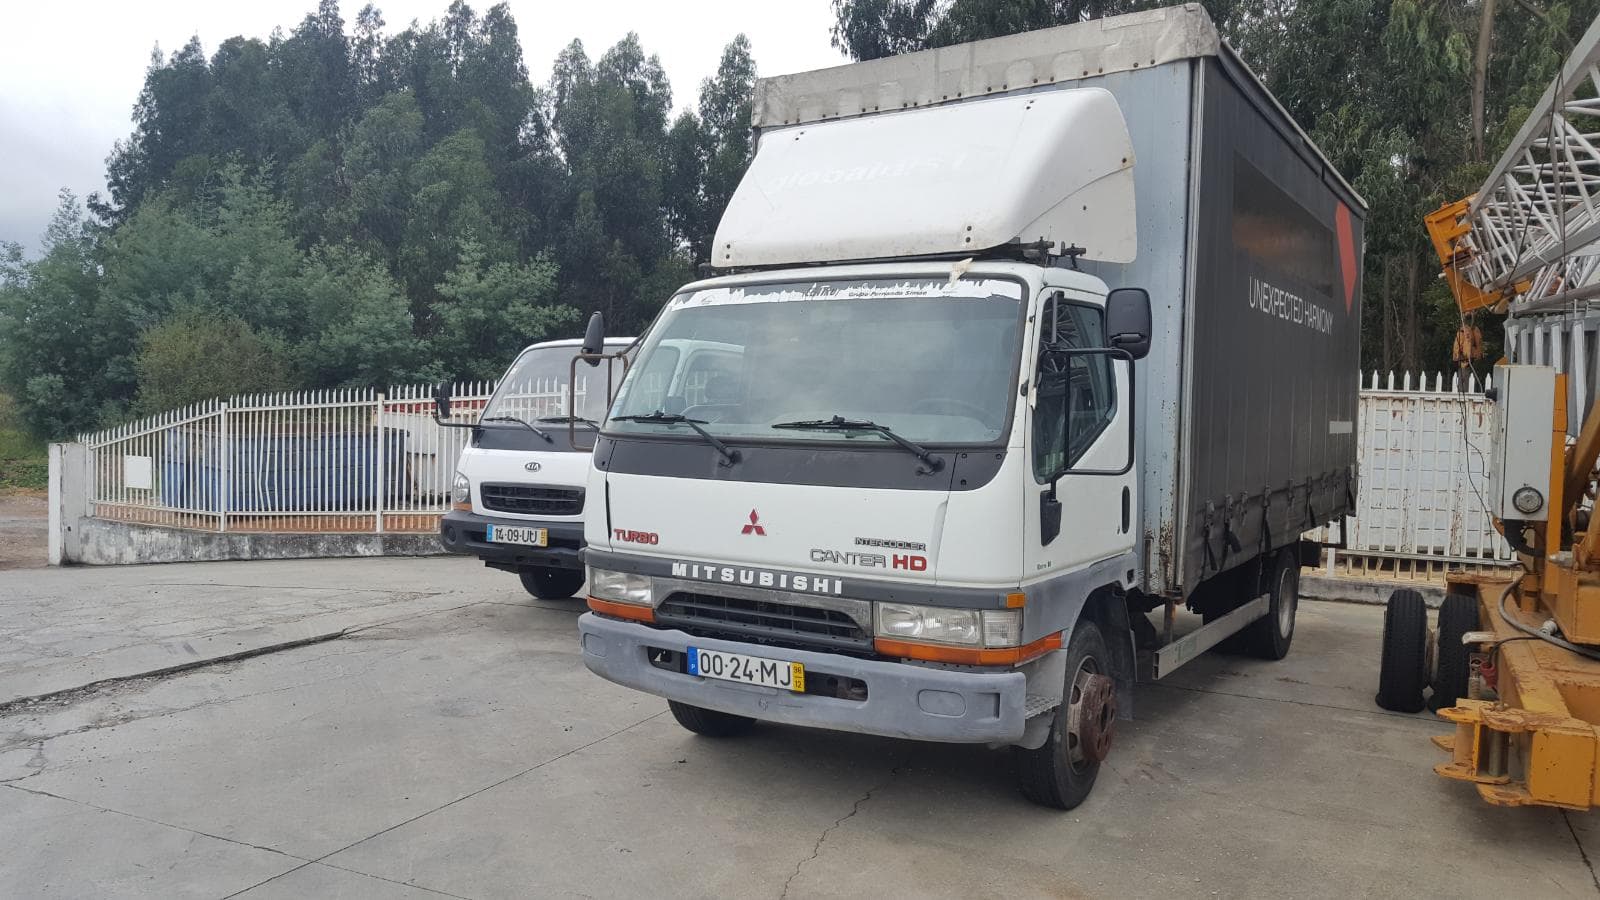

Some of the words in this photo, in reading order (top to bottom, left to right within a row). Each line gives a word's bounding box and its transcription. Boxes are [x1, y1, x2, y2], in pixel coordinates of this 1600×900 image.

[1249, 275, 1303, 324] UNEXPECTED
[1304, 301, 1334, 335] HARMONY
[614, 529, 659, 545] TURBO
[855, 537, 926, 551] INTERCOOLER
[810, 549, 886, 568] CANTER
[893, 554, 927, 571] HD
[672, 562, 842, 595] MITSUBISHI
[795, 680, 802, 688] 12
